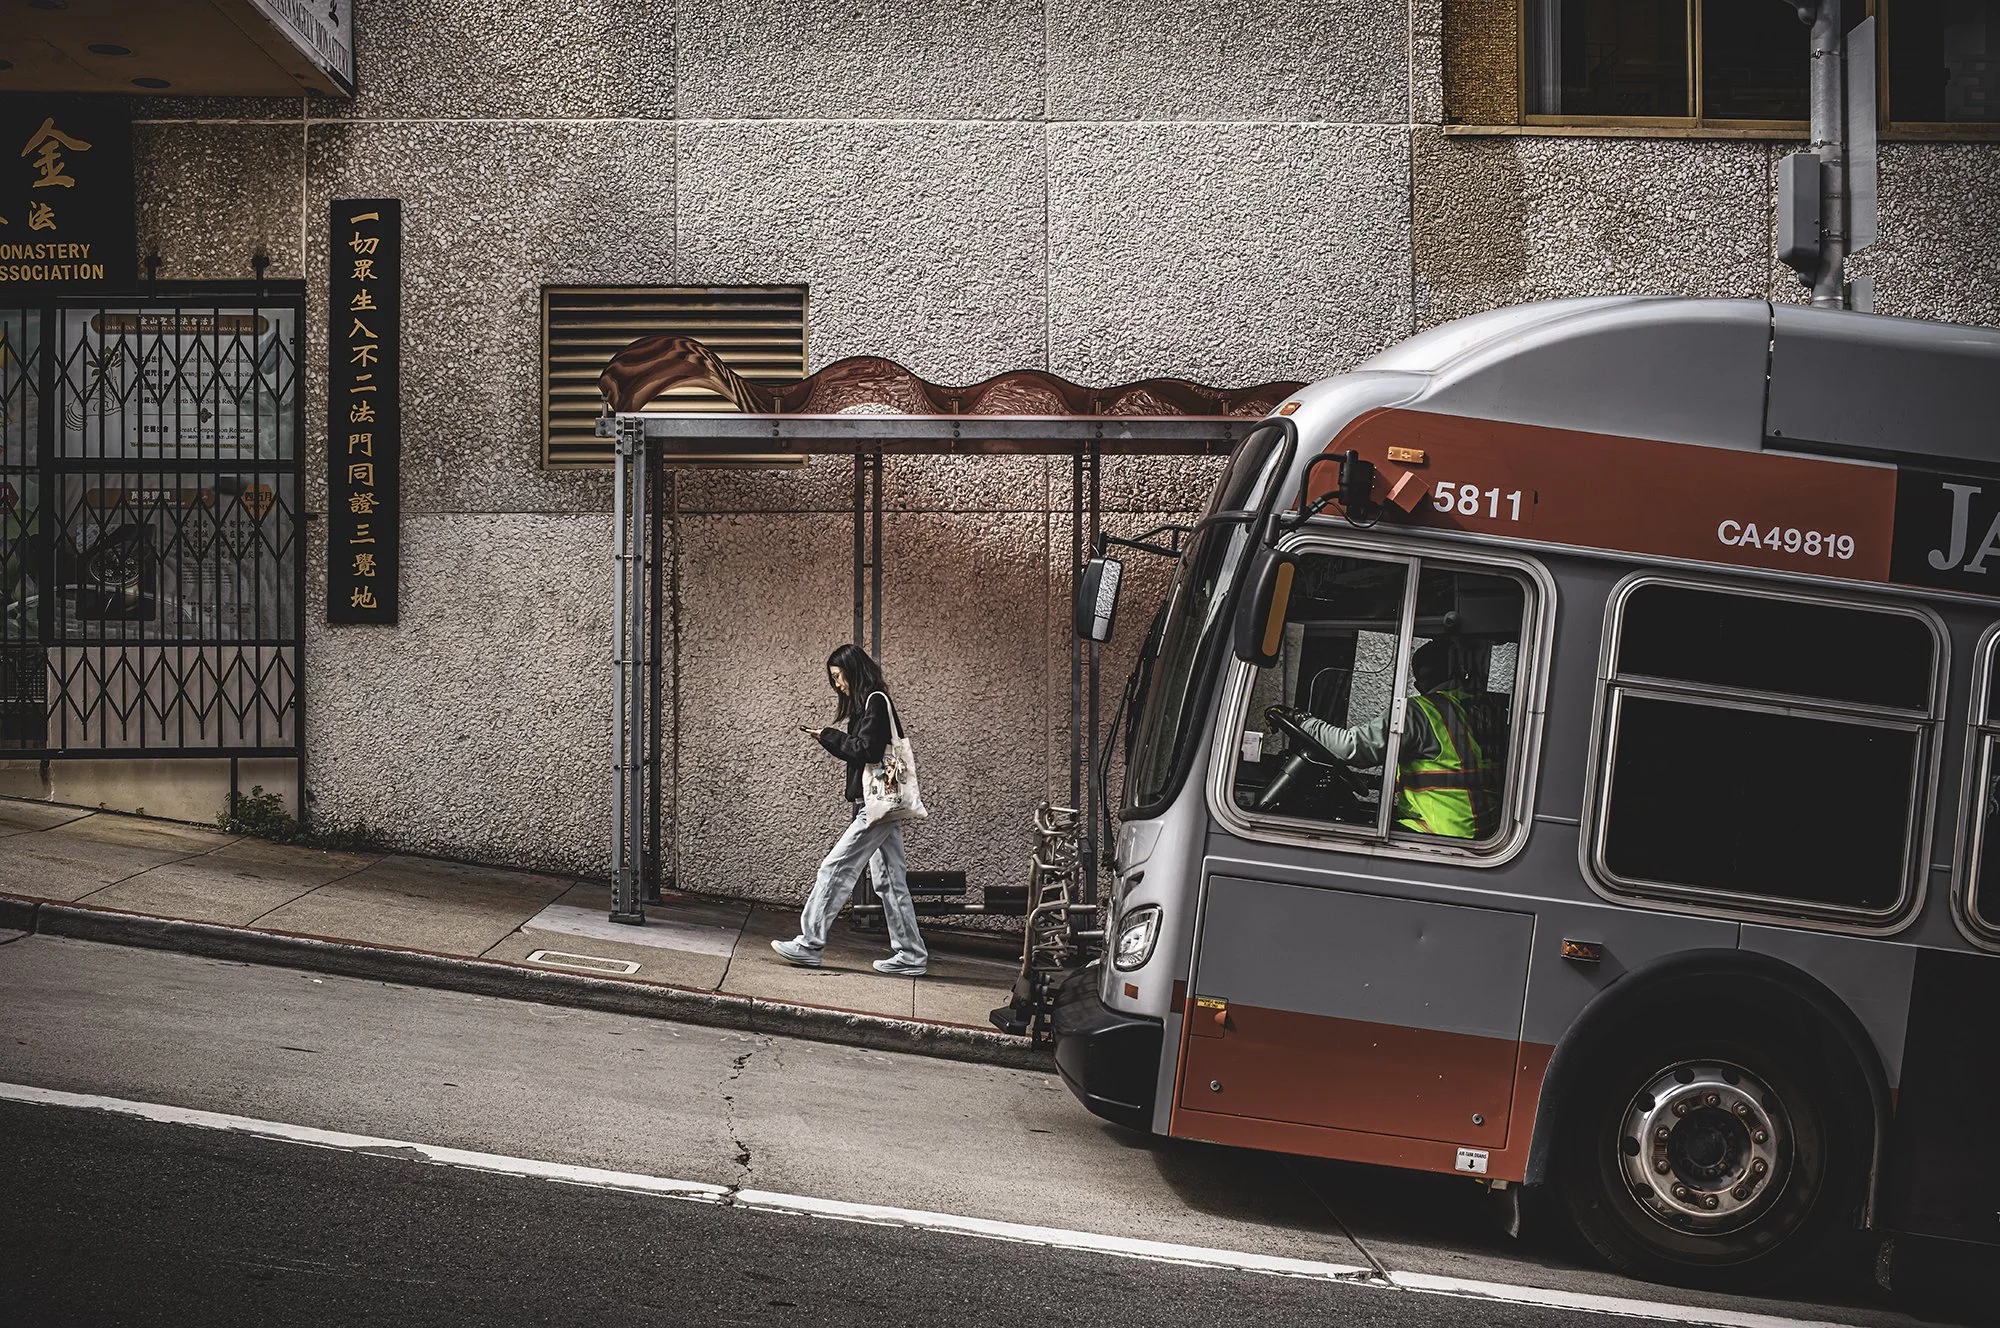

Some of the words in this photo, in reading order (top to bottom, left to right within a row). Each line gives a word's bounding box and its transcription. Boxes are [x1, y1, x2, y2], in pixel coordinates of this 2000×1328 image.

[21, 117, 93, 189] 金
[1432, 481, 1523, 521] 5811
[1717, 518, 1856, 562] CA49819
